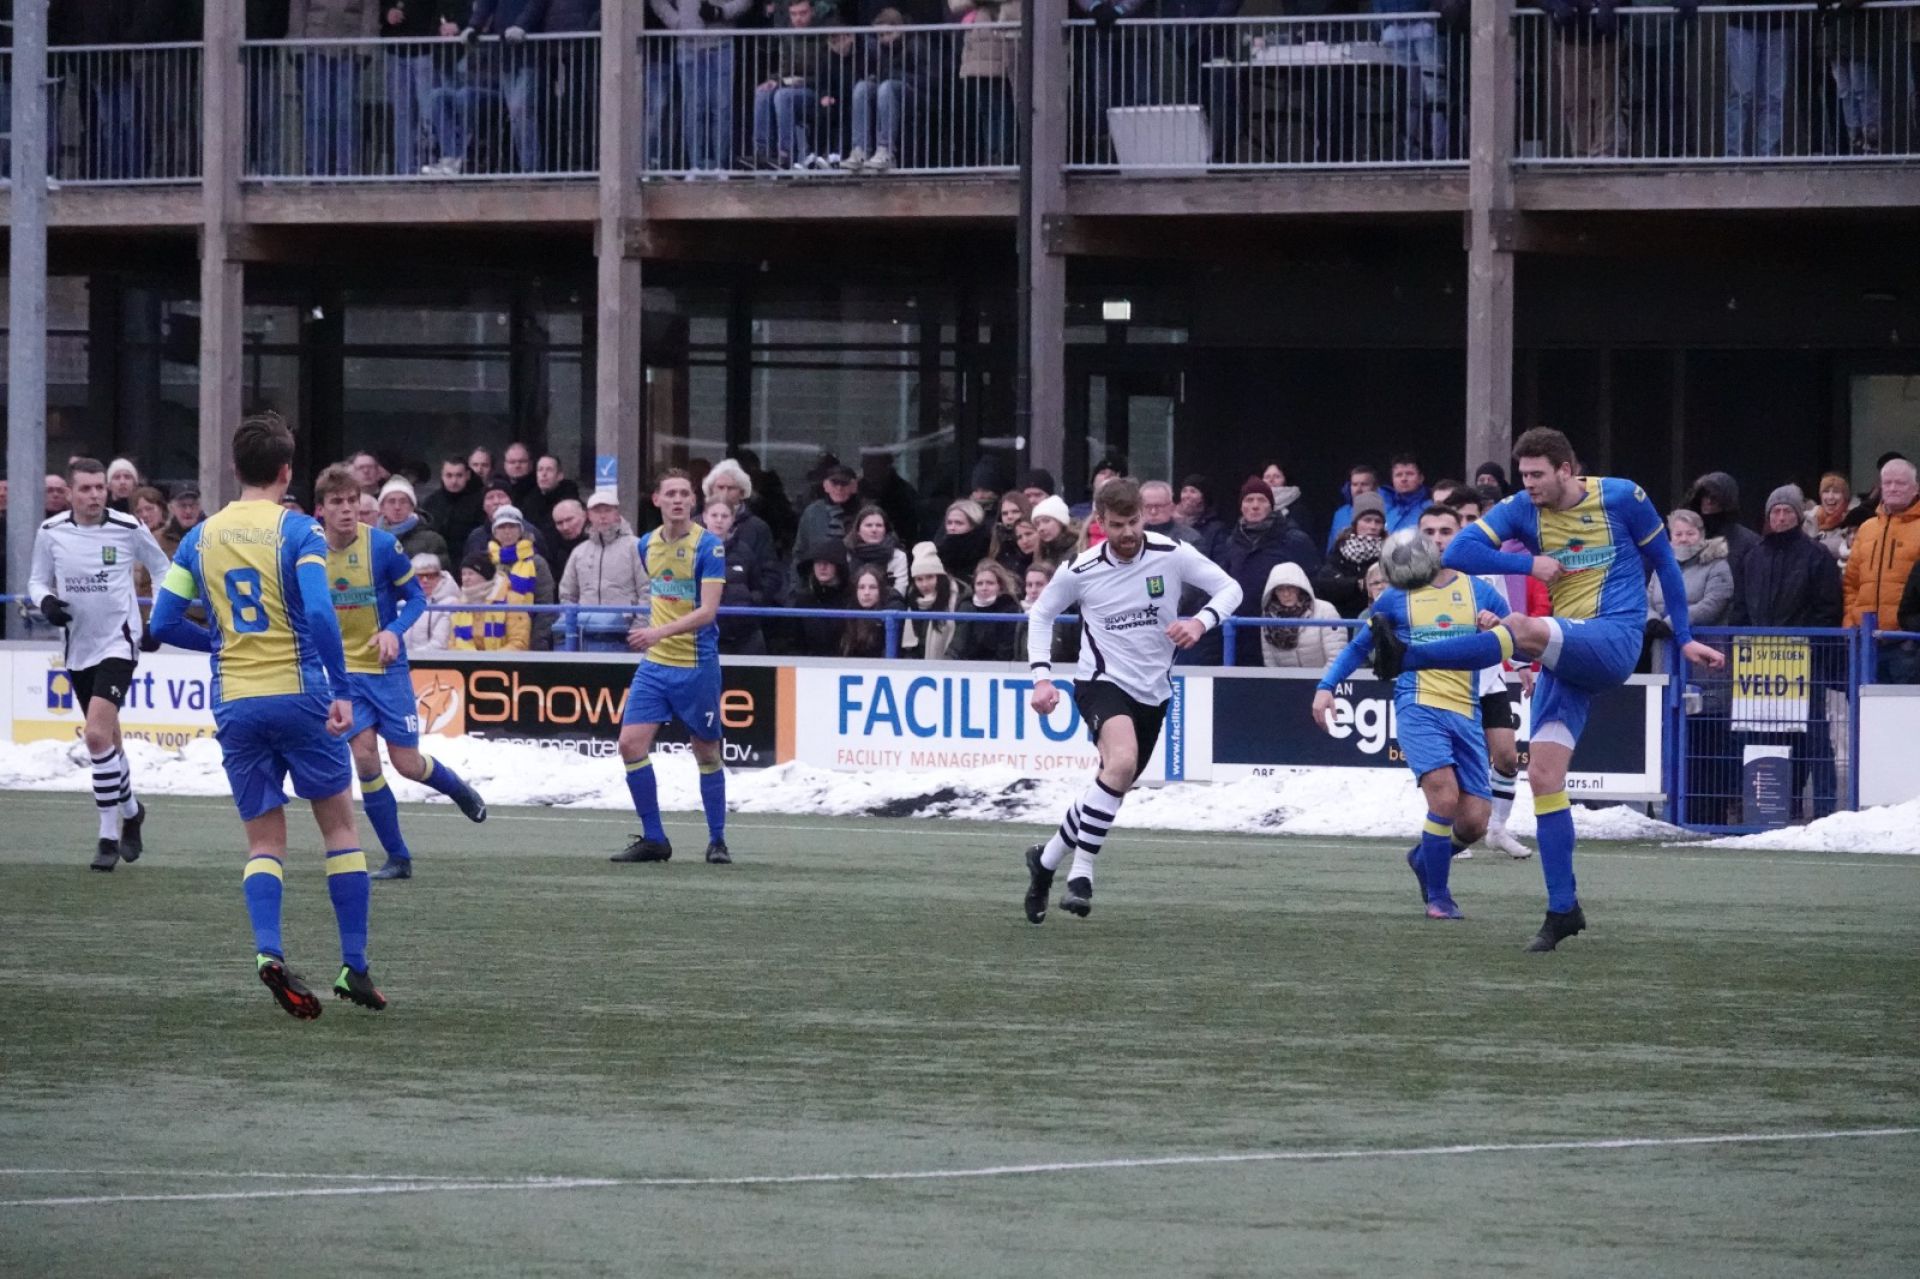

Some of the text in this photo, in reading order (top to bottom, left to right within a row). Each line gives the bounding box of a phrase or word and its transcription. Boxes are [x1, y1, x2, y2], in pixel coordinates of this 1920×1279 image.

[224, 567, 270, 633] 8
[1104, 619, 1158, 630] SPONSORS
[1739, 674, 1804, 696] VELD 1
[839, 675, 1095, 742] FACILITO
[405, 715, 418, 732] 16
[705, 712, 715, 727] 7
[1170, 681, 1181, 776] www.facilitor.nl
[838, 749, 902, 767] FACILITY
